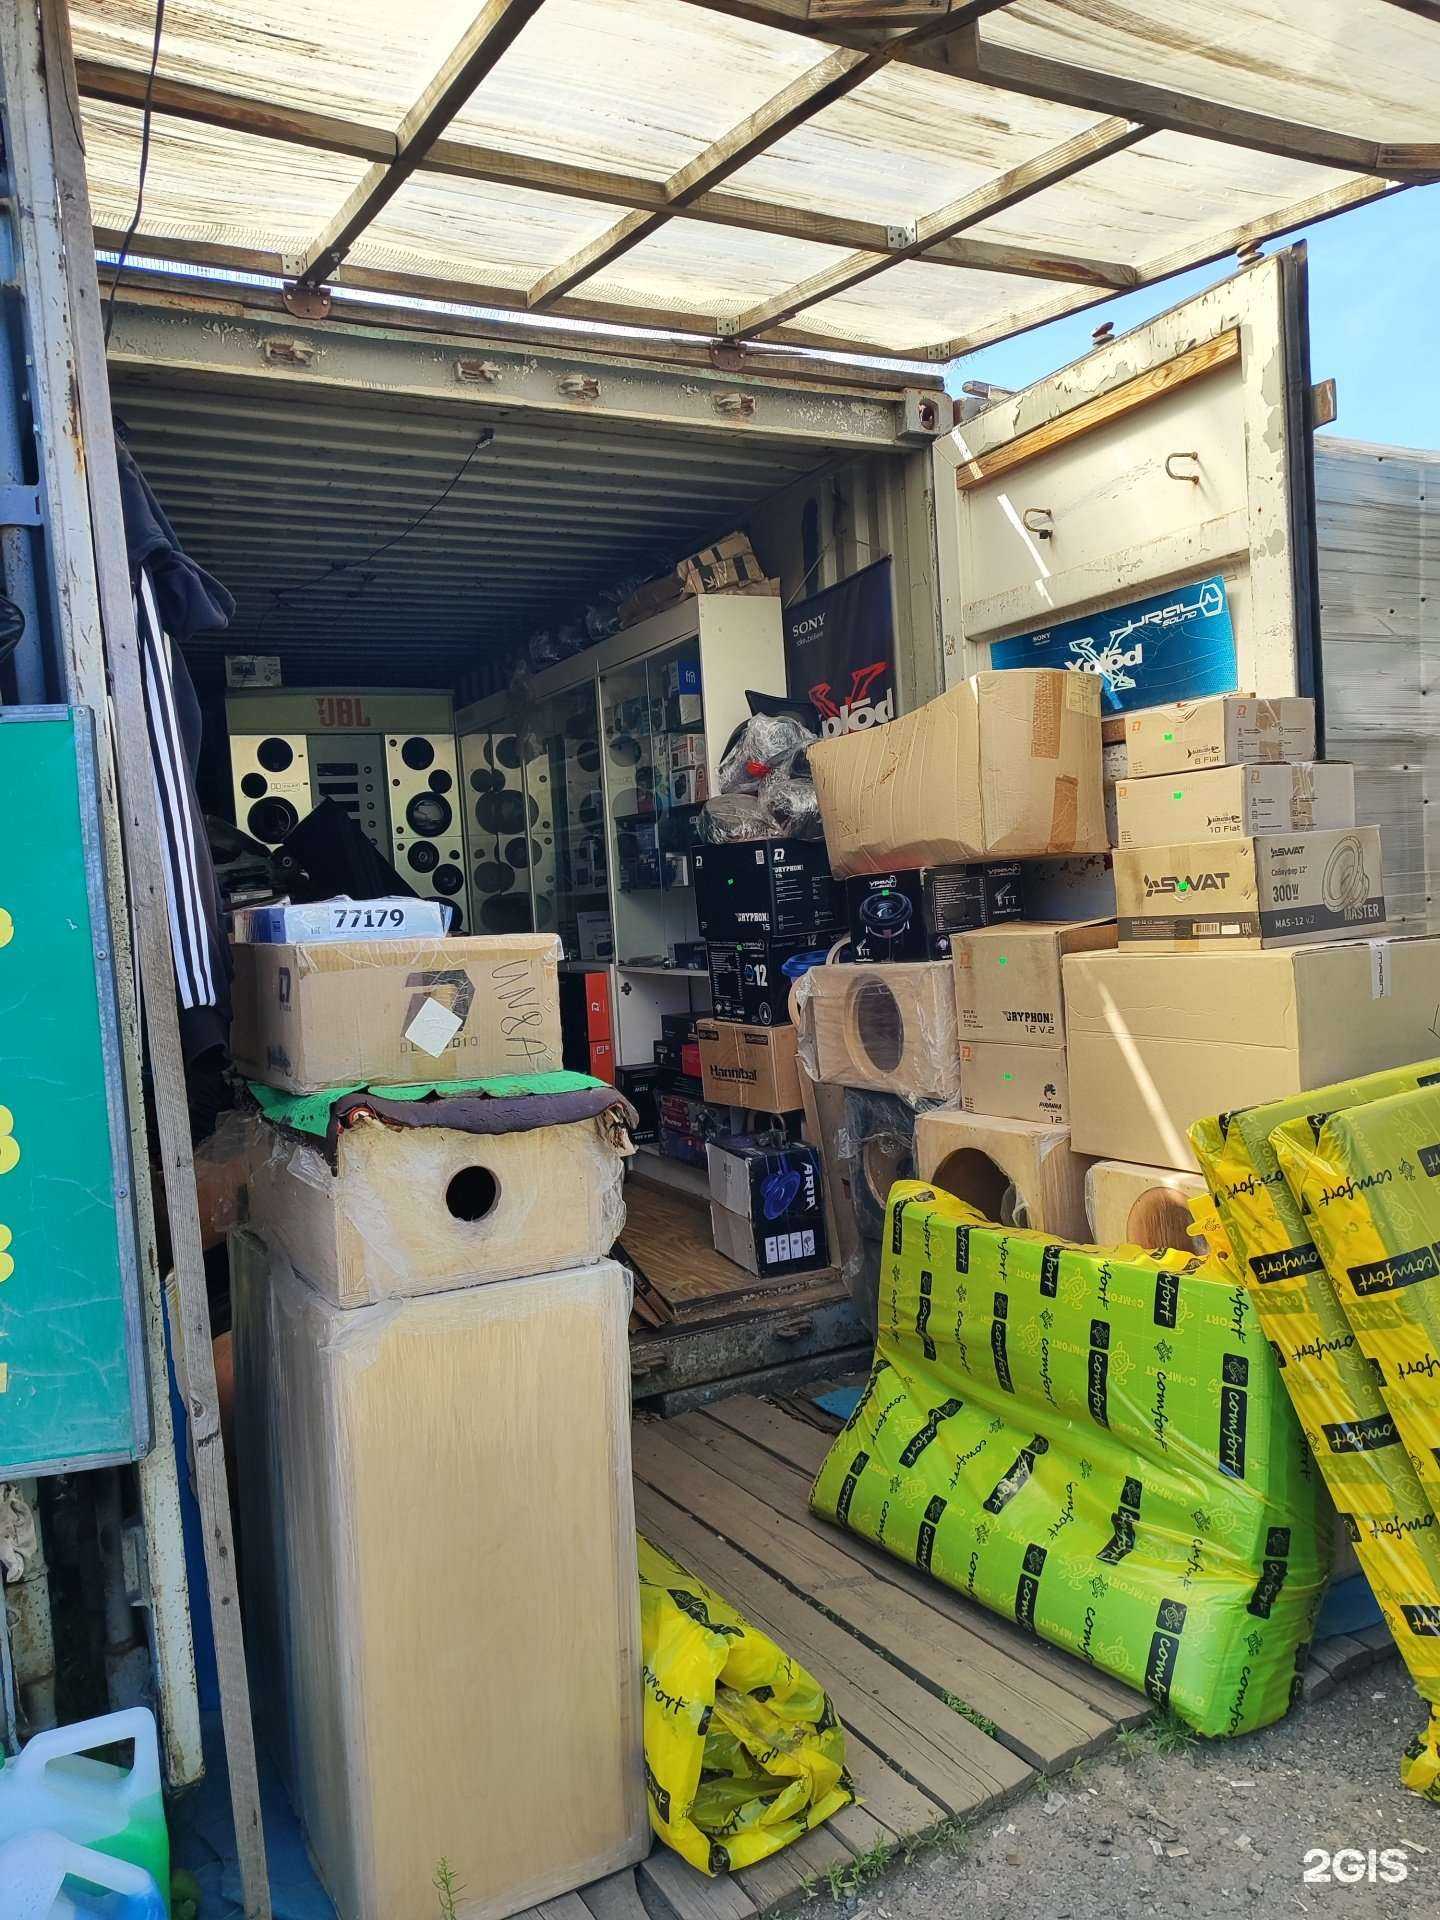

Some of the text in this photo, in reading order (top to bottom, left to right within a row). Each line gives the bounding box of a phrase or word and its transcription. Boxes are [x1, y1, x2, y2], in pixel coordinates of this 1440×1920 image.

[793, 612, 826, 638] SONY
[1032, 632, 1052, 643] SONY
[319, 697, 371, 728] JBL
[1203, 755, 1220, 764] Flat
[1223, 825, 1241, 833] Flat
[1274, 845, 1305, 857] SWAT
[1154, 872, 1230, 894] SWAT
[333, 908, 405, 928] 77179
[1275, 917, 1304, 929] MAS-12
[1343, 903, 1380, 920] MASTER
[762, 923, 771, 931] 15
[753, 963, 769, 987] 12
[1025, 1024, 1037, 1034] 12
[709, 1063, 758, 1081] Hannibal
[1049, 1115, 1063, 1124] 12
[800, 1161, 816, 1212] ARIA
[1319, 1168, 1393, 1207] comfort
[1359, 1255, 1434, 1292] comfort
[994, 1323, 1010, 1386] comfort
[1039, 1338, 1061, 1410] comfort
[1090, 1354, 1107, 1428] comfort
[871, 1394, 907, 1446] comfort
[1151, 1371, 1169, 1452] comfort
[1222, 1392, 1243, 1474] comfort
[949, 1440, 988, 1491] comfort
[1048, 1481, 1079, 1540] comfort
